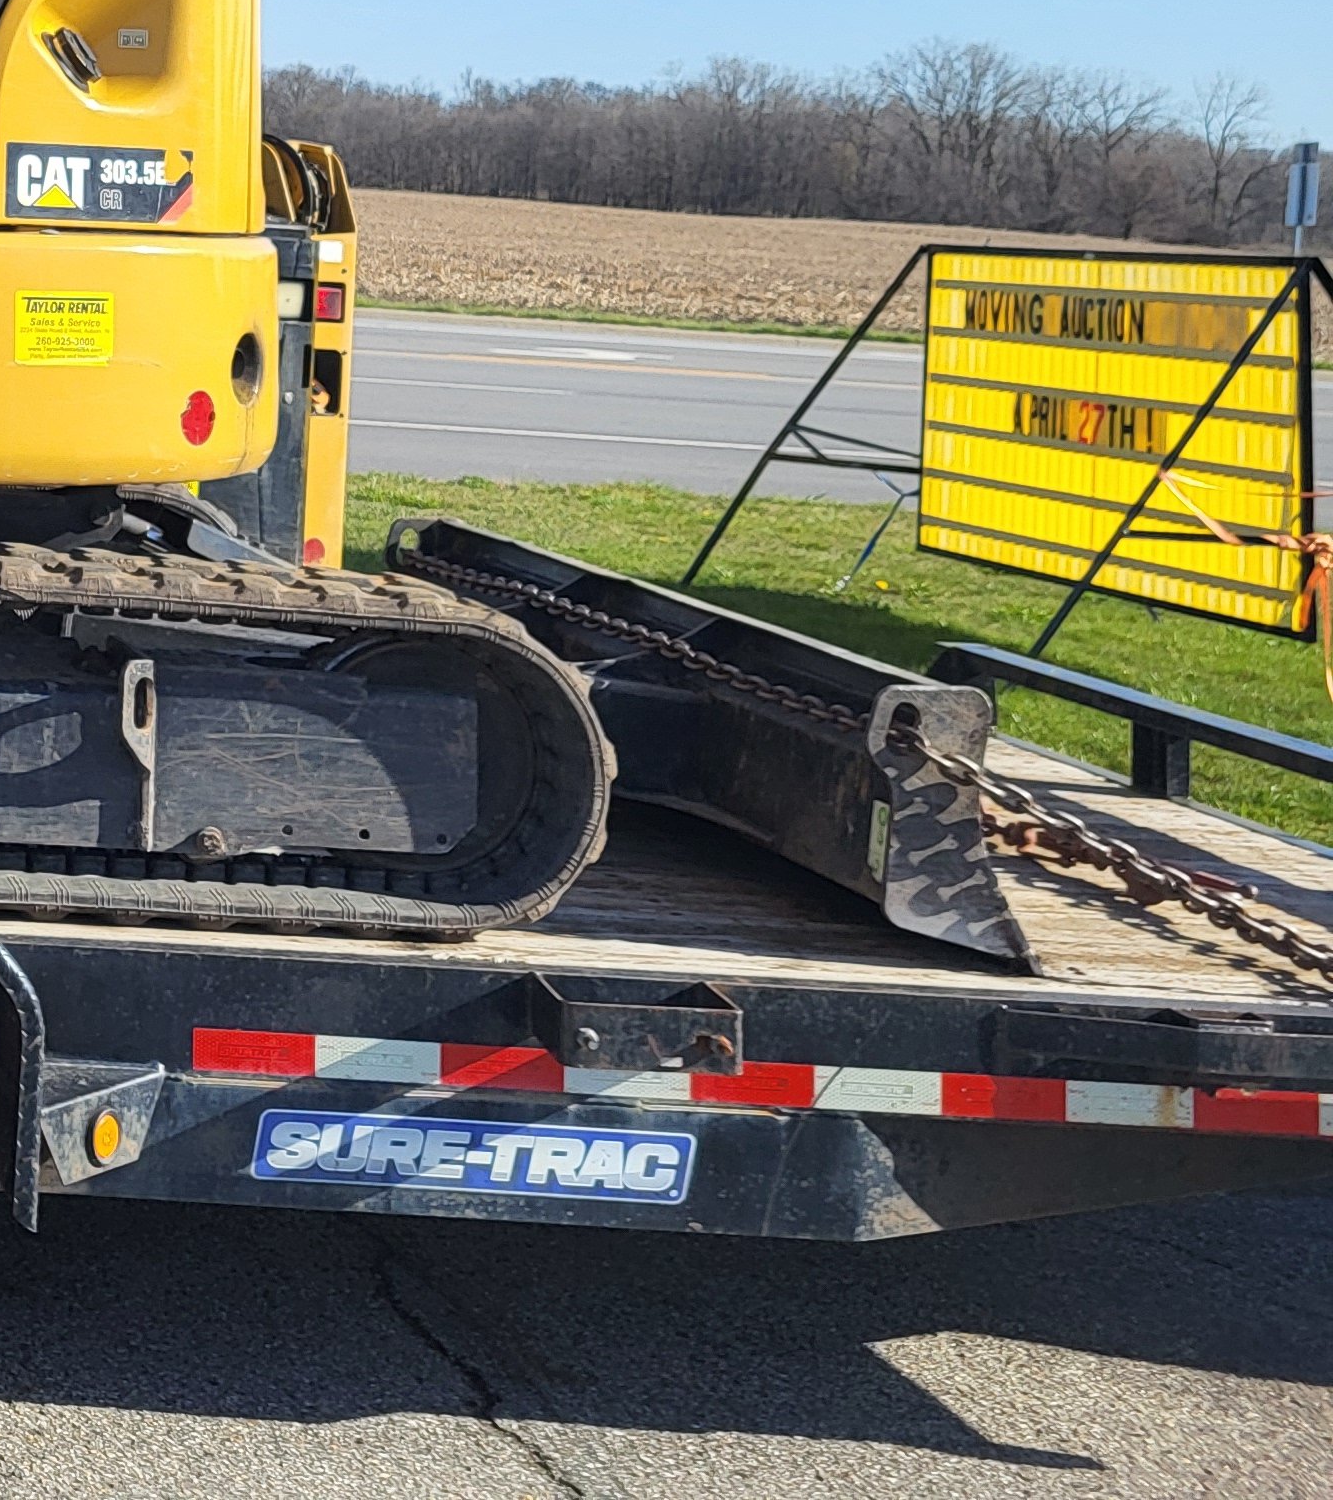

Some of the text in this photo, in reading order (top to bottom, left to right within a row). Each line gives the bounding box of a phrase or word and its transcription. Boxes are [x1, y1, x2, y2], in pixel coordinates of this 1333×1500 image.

[17, 154, 176, 210] CAT 303.5E
[99, 188, 123, 210] CR
[23, 297, 108, 314] TAYLOR RENTAL
[30, 317, 101, 328] Sales & Service
[965, 290, 1145, 344] MOVING AUCTION
[1014, 393, 1068, 441] APRIL
[266, 1121, 682, 1192] SURE-TRAC
